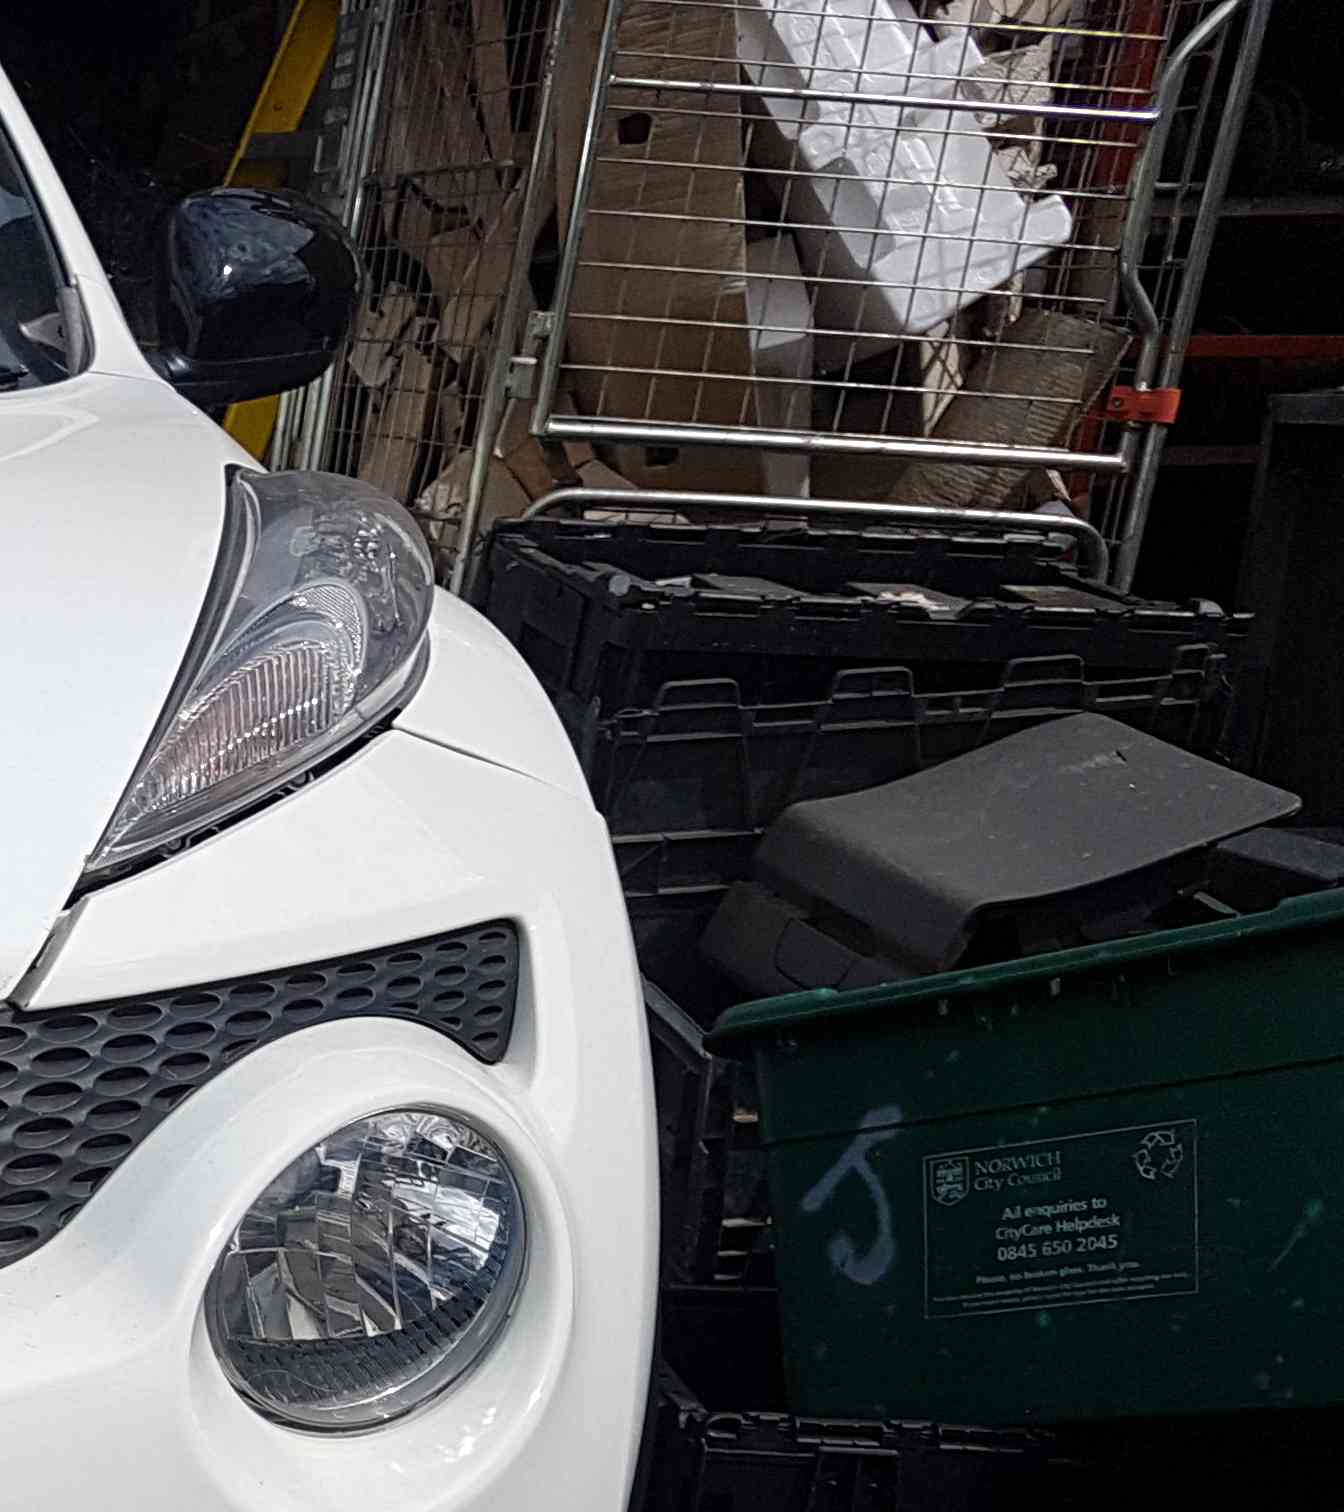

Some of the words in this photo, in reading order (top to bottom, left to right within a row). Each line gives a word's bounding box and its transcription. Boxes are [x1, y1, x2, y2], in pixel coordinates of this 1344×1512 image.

[975, 1150, 1061, 1175] NORWICH
[973, 1176, 1004, 1192] City
[1007, 1167, 1062, 1187] Council
[1002, 1205, 1021, 1220] All
[1024, 1199, 1088, 1218] enquiries
[1092, 1197, 1107, 1209] to
[995, 1223, 1053, 1241] CityCare
[1055, 1213, 1120, 1233] Helpdesk
[997, 1243, 1037, 1261] 0845
[1041, 1239, 1072, 1256] 650
[1076, 1234, 1118, 1252] 2045
